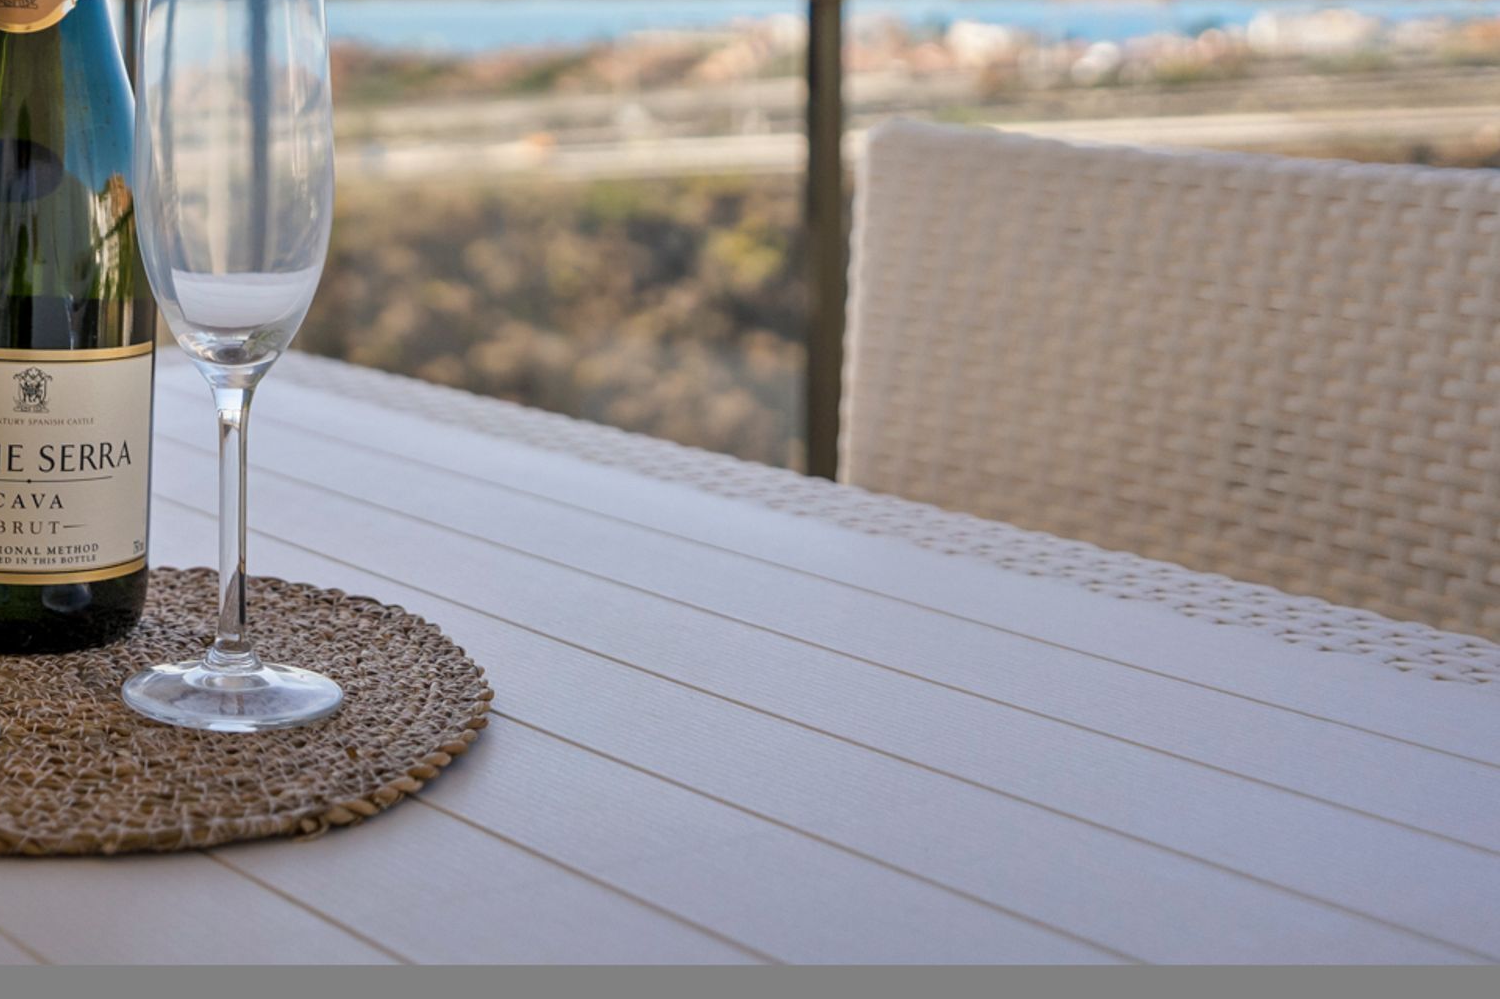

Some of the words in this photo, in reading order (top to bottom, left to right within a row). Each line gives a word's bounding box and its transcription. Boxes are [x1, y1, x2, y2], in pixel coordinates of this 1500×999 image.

[28, 418, 65, 426] SPANISH
[66, 417, 94, 425] CASTLE
[39, 440, 132, 472] SERRA
[47, 543, 99, 555] METHOD
[16, 556, 28, 564] IN
[33, 556, 57, 564] THIS
[61, 555, 97, 563] BOTTLE
